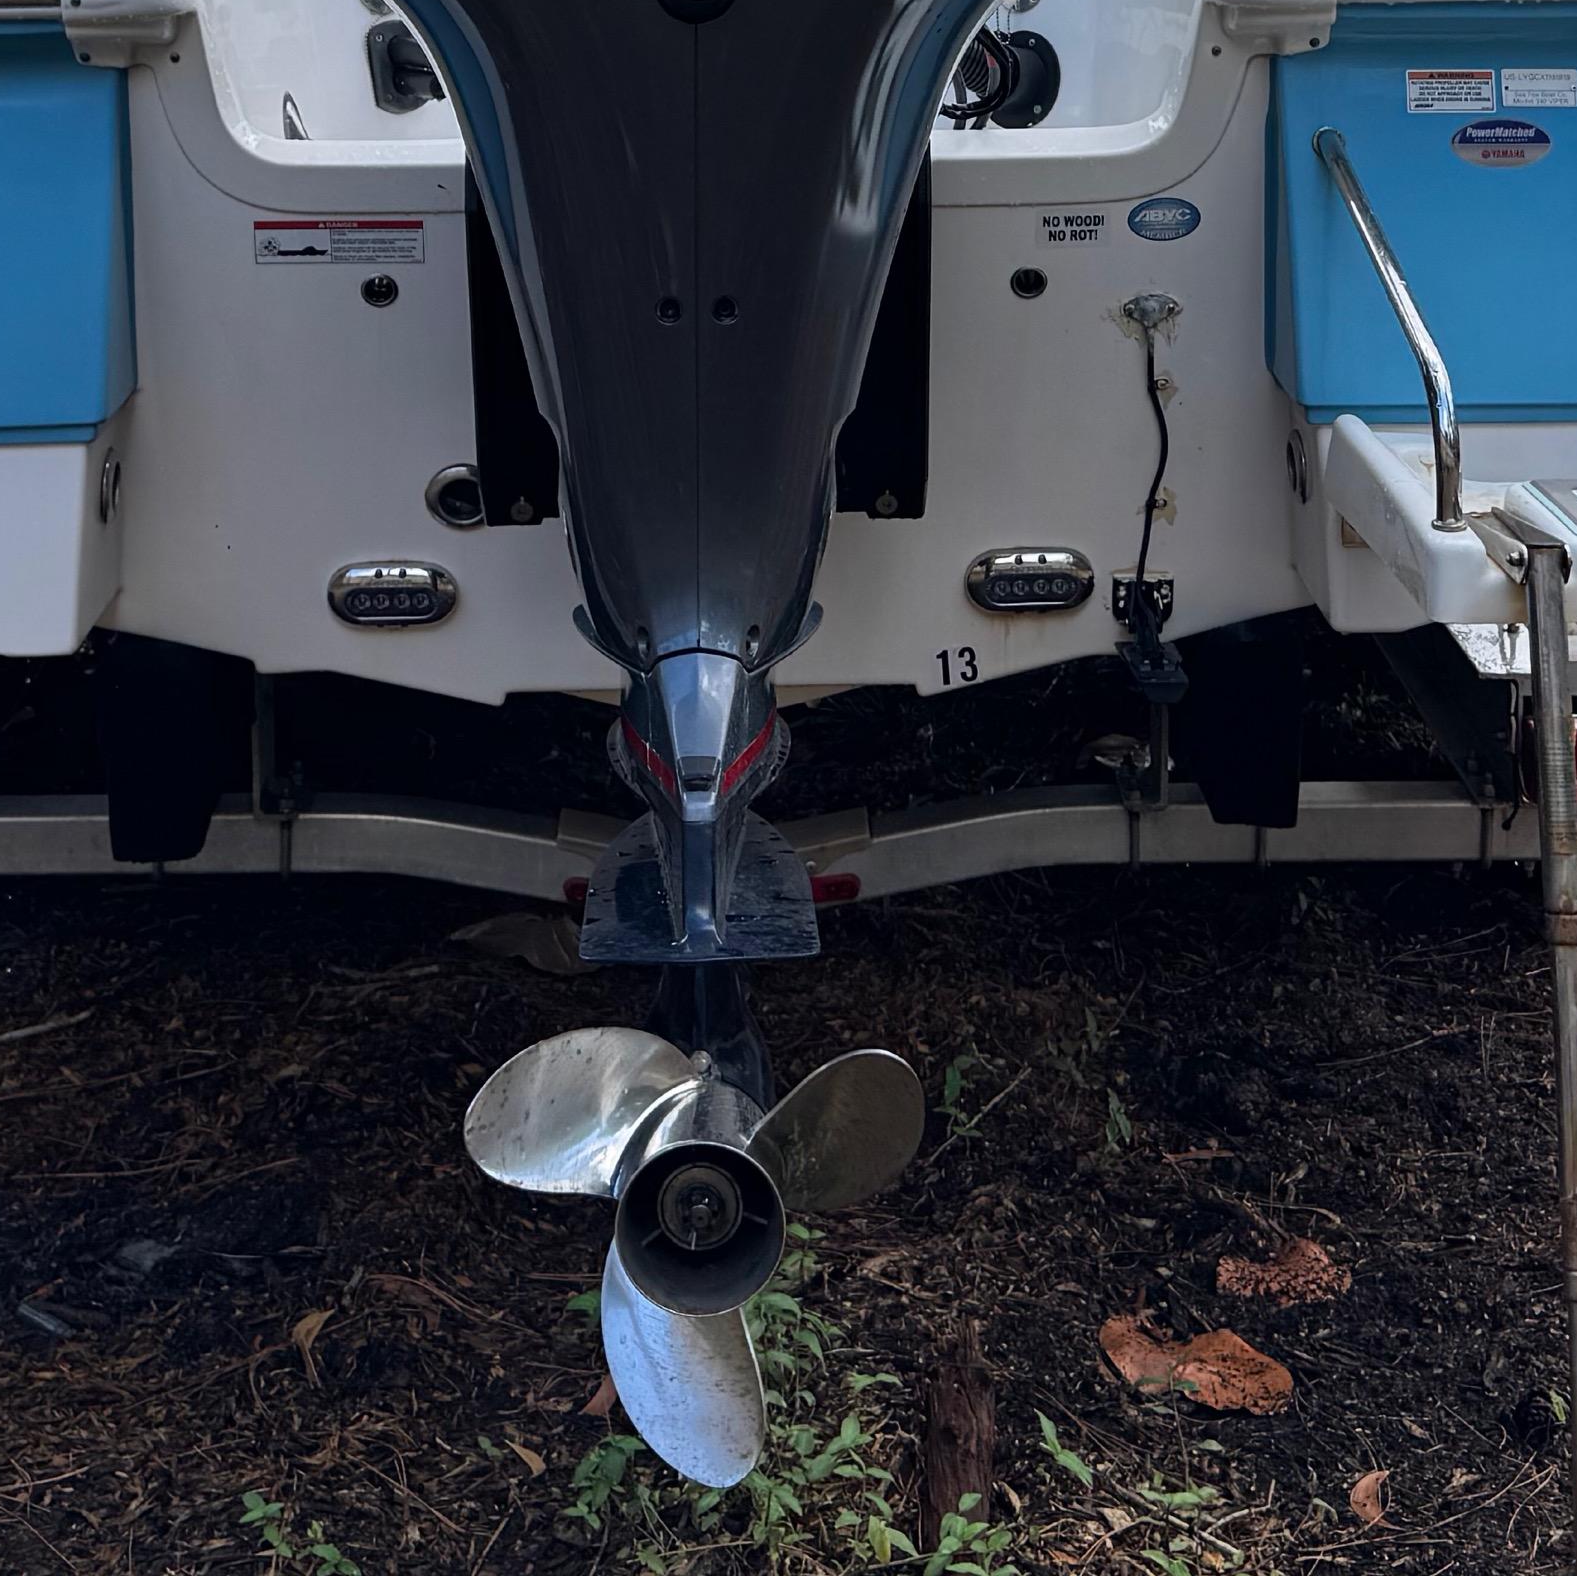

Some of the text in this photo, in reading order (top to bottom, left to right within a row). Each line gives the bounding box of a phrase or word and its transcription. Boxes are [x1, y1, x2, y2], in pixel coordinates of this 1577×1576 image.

[1466, 127, 1536, 137] PowerMatched
[1492, 150, 1525, 158] YAMAHA
[1134, 208, 1191, 223] ABYC
[1043, 216, 1060, 227] NO
[1048, 230, 1098, 242] NO ROT!
[936, 646, 979, 686] 13
